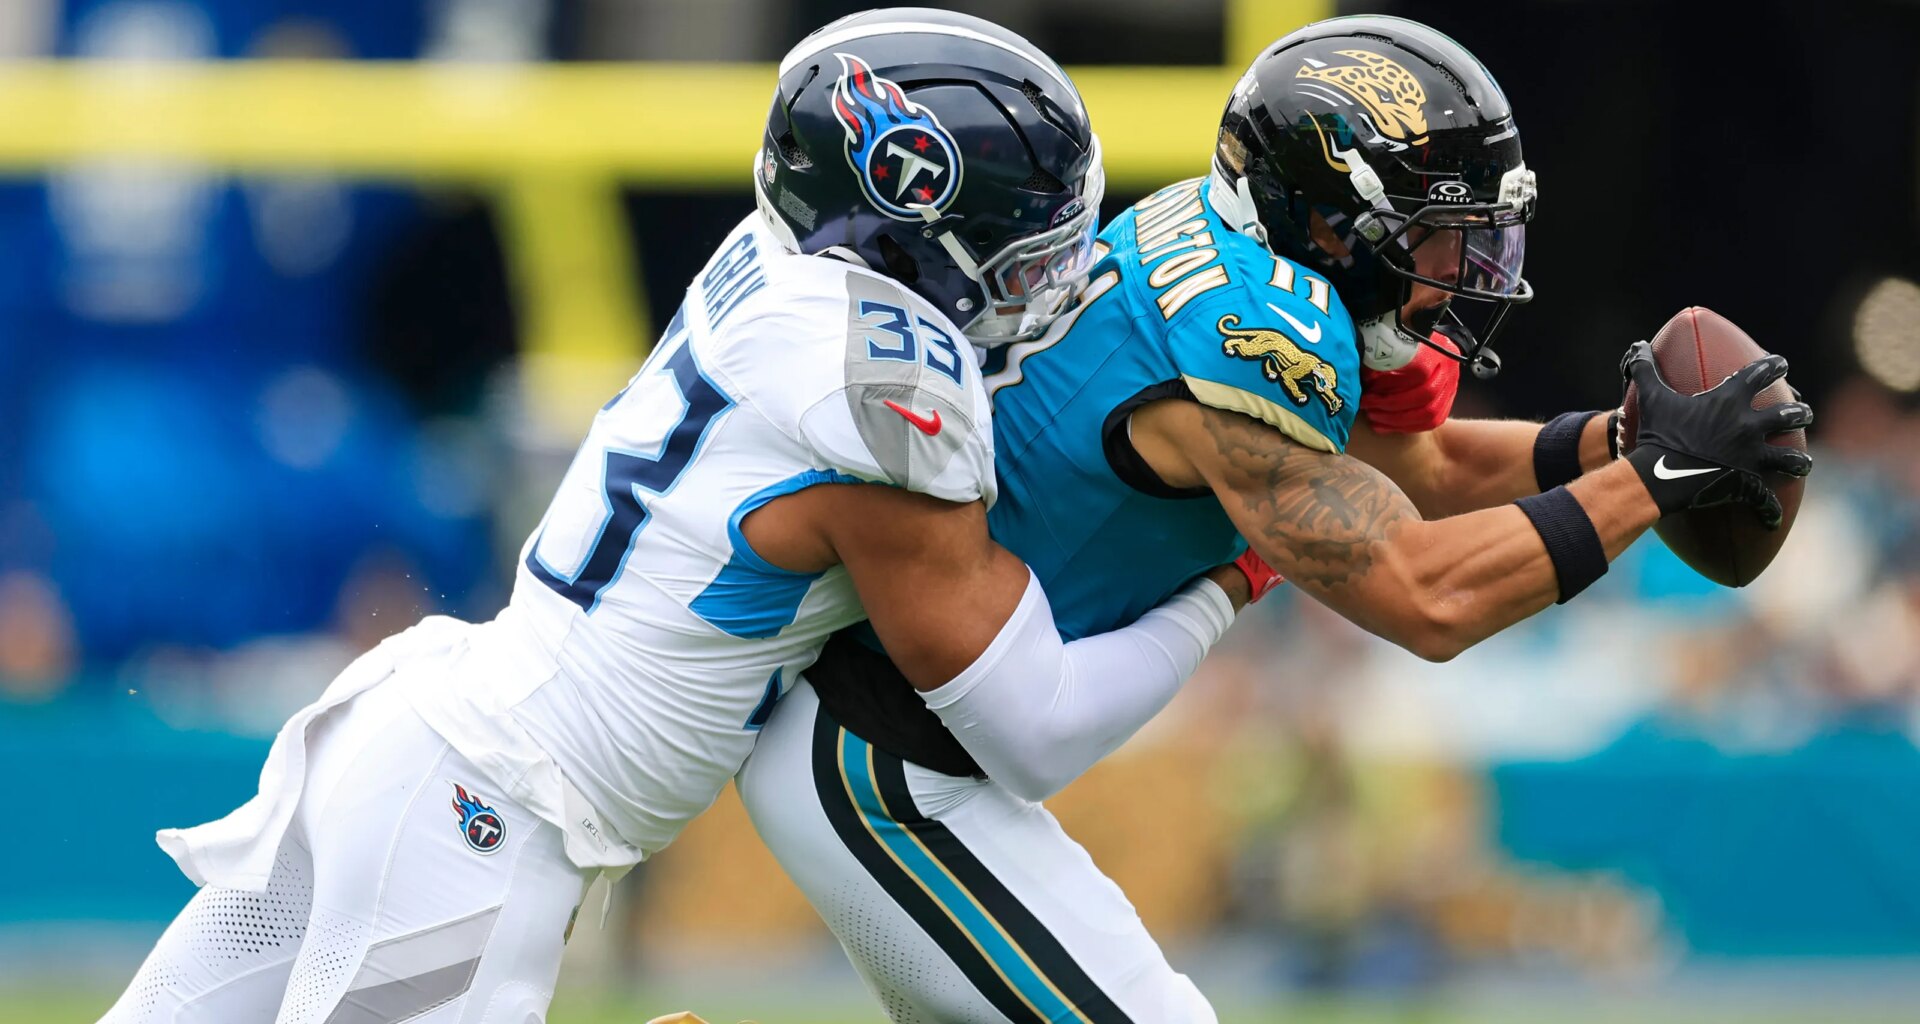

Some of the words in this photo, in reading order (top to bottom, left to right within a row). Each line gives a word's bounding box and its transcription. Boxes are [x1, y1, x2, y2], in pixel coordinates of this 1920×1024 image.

[1430, 193, 1472, 203] OAKLEY
[702, 231, 768, 334] GRAY
[1266, 254, 1331, 318] 11
[858, 299, 965, 389] 33
